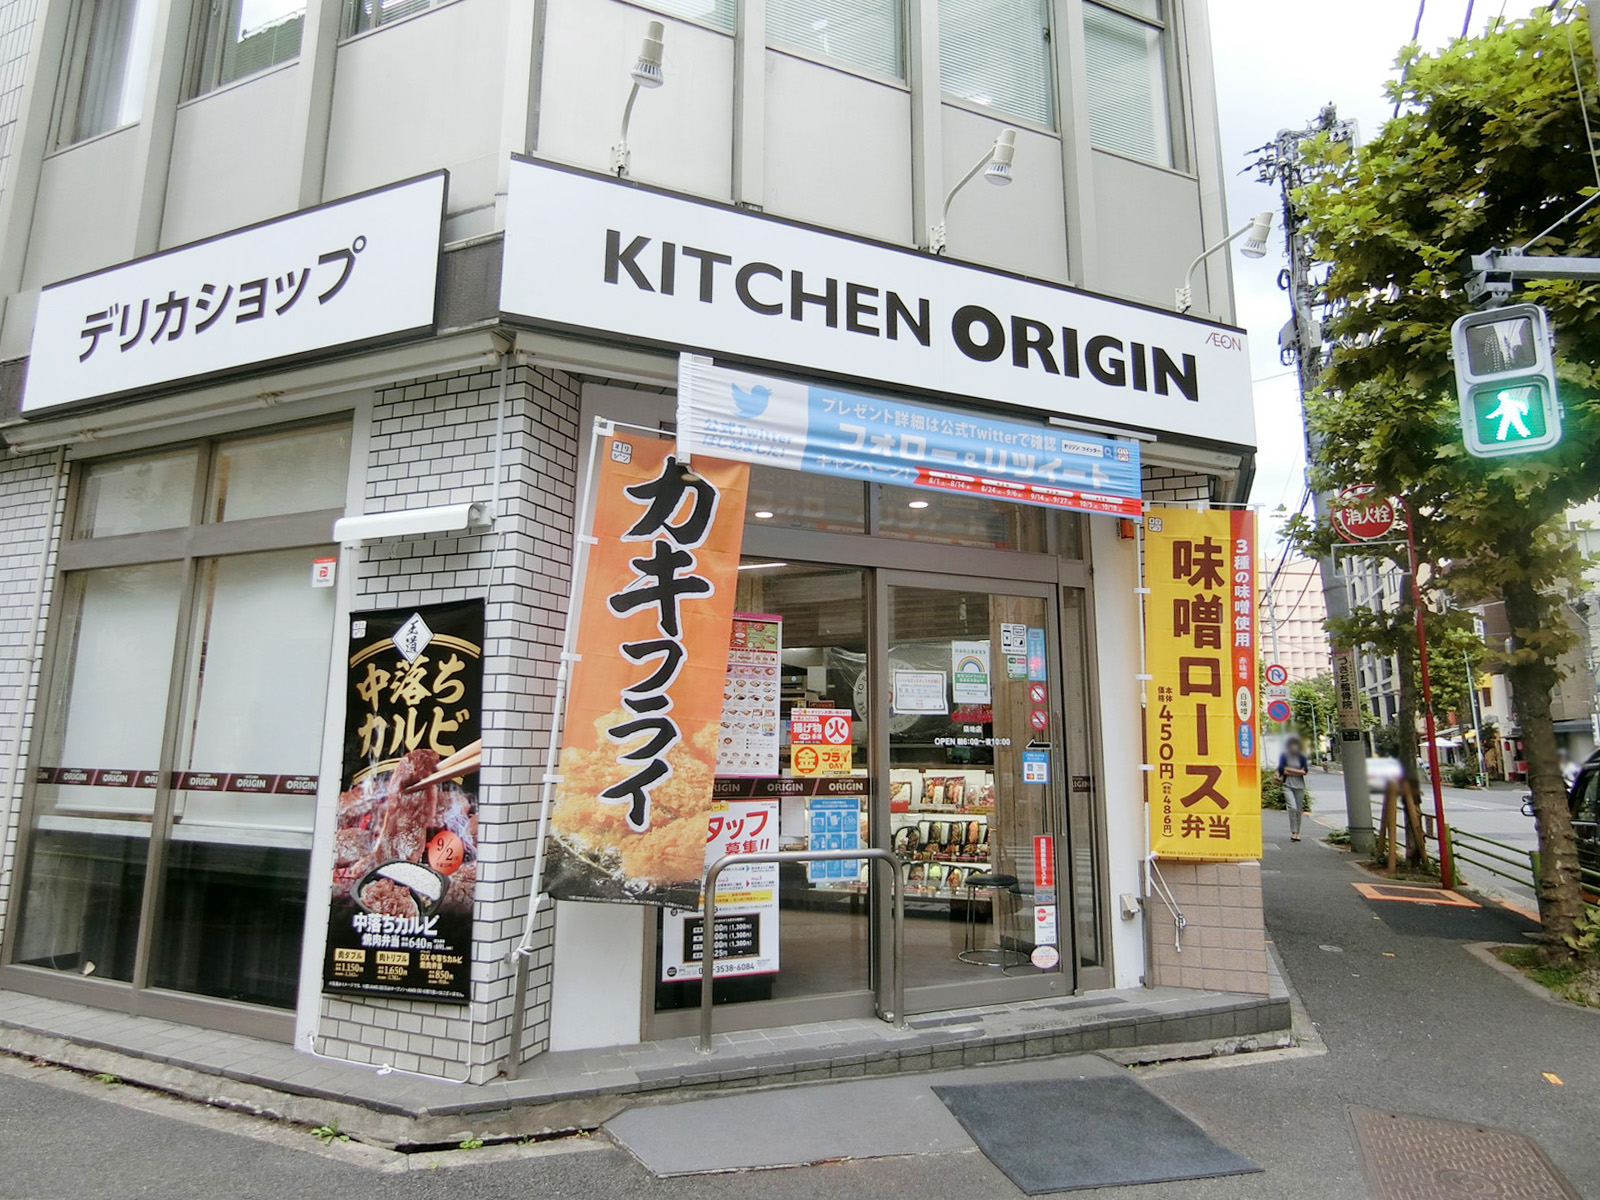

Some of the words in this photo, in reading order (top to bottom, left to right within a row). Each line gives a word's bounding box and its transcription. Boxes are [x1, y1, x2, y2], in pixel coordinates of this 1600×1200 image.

[78, 235, 367, 363] デリカショップ
[603, 228, 932, 347] KITCHEN
[951, 303, 1199, 402] ORIGIN
[822, 397, 1057, 452] プレゼント詳細は公式Twitterで確認
[839, 422, 1110, 489] フォロー&リツイート
[1233, 539, 1250, 647] 3種の味噌使用
[600, 455, 717, 828] カキフライ
[356, 653, 467, 712] 中落ち
[1172, 536, 1229, 810] 味噌ロース
[357, 705, 471, 758] カルビ
[828, 719, 846, 739] 火
[934, 737, 956, 746] OPEN
[1158, 704, 1174, 779] 450円
[102, 774, 128, 784] ORIGIN
[189, 777, 218, 787] ORIGIN
[236, 778, 266, 789] ORIGIN
[286, 780, 318, 791] ORIGIN
[766, 783, 804, 792] ORIGIN
[828, 782, 864, 792] ORIGIN
[1181, 814, 1231, 840] 弁当
[436, 839, 454, 861] 9/2
[352, 912, 440, 936] 中落ちカルビ
[408, 936, 433, 949] 640円
[698, 962, 755, 976] 0-3538-6084
